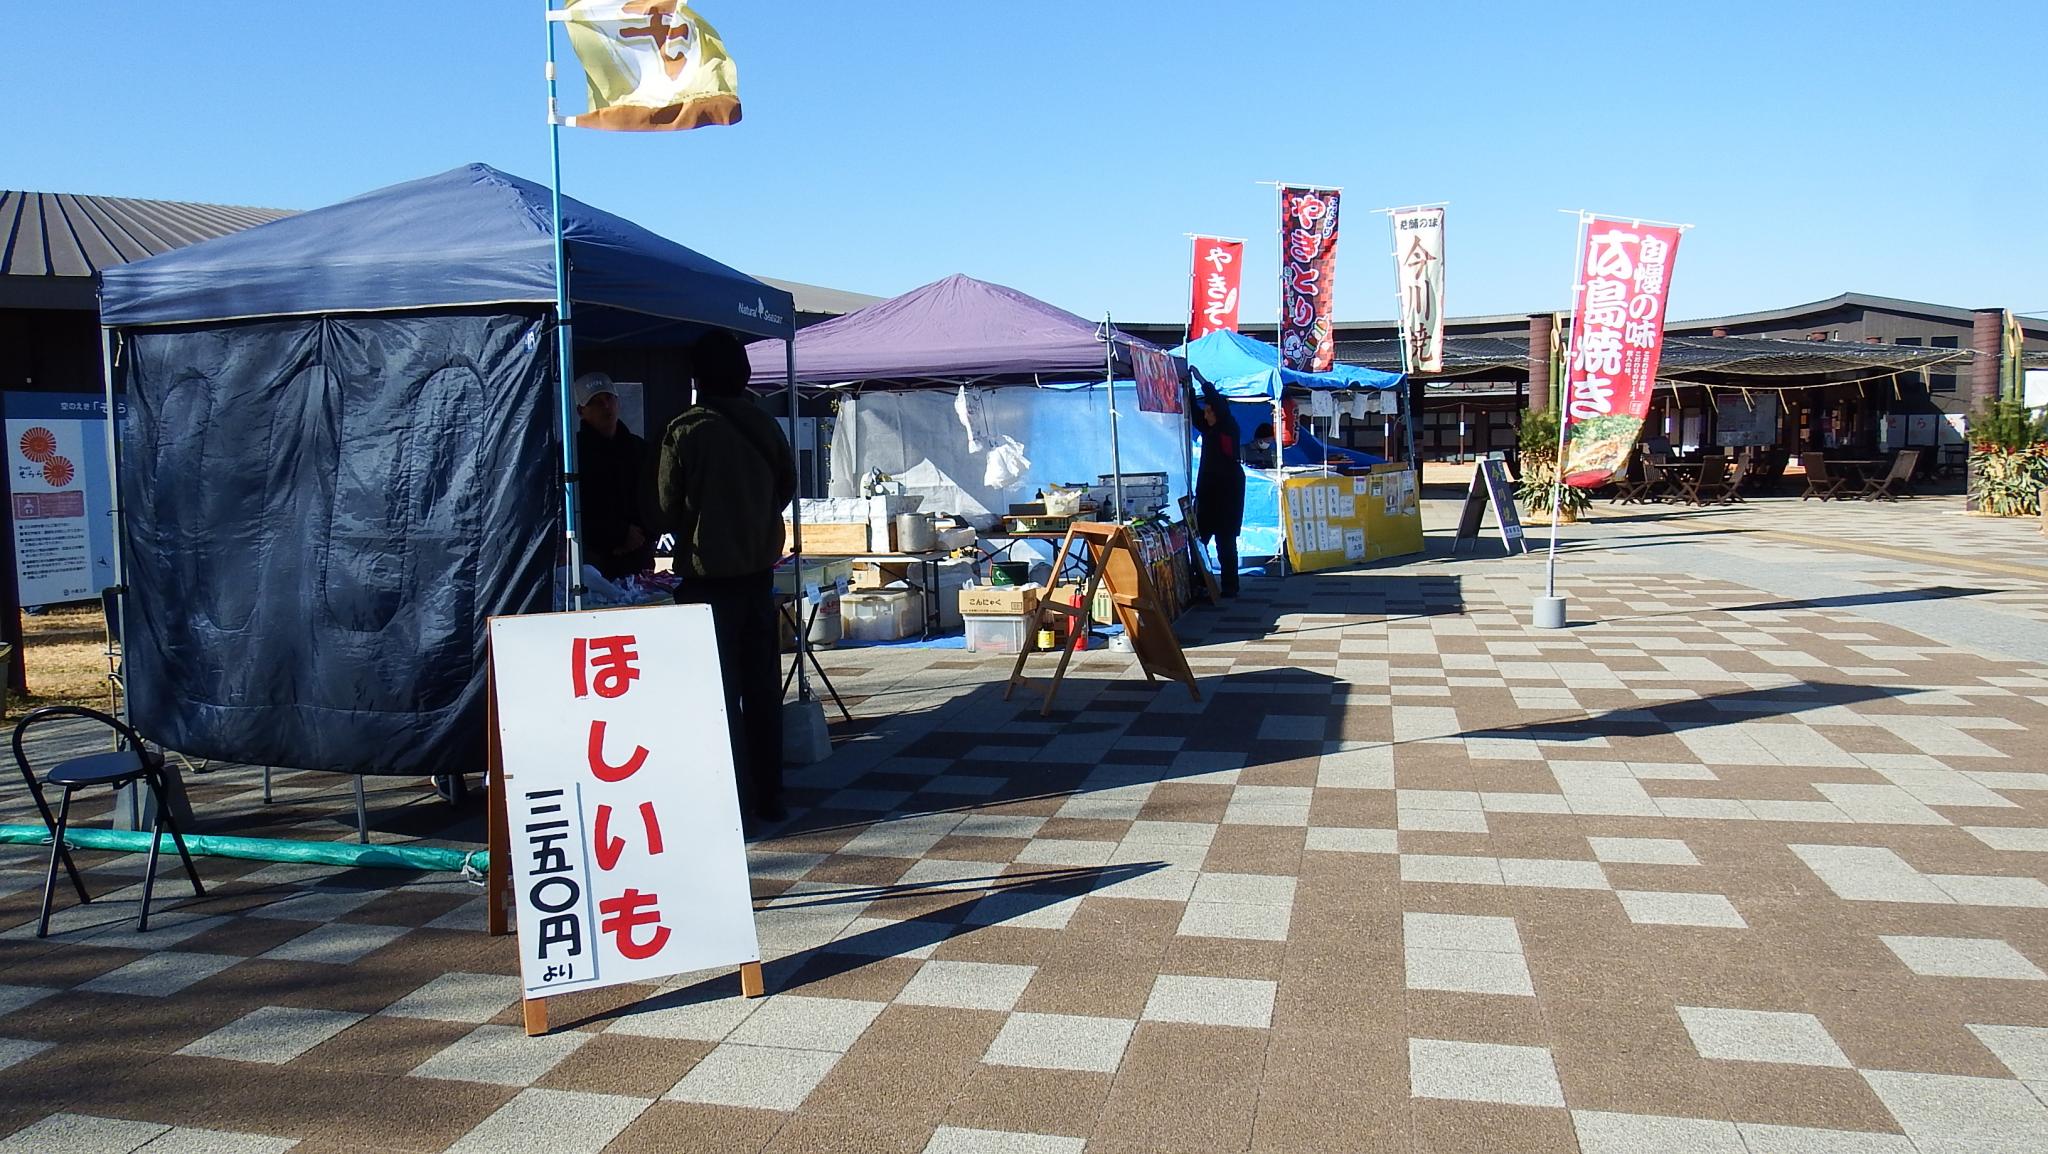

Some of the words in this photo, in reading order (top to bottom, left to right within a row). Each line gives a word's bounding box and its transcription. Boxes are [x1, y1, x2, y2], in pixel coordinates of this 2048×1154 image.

[1291, 194, 1327, 328] やきとり
[1404, 234, 1437, 363] 今川焼
[1569, 229, 1640, 420] 広島焼き
[1624, 234, 1668, 350] 自慢の味
[969, 598, 1002, 606] こんにゃく
[571, 634, 672, 961] ほしいも
[543, 965, 573, 982] より
